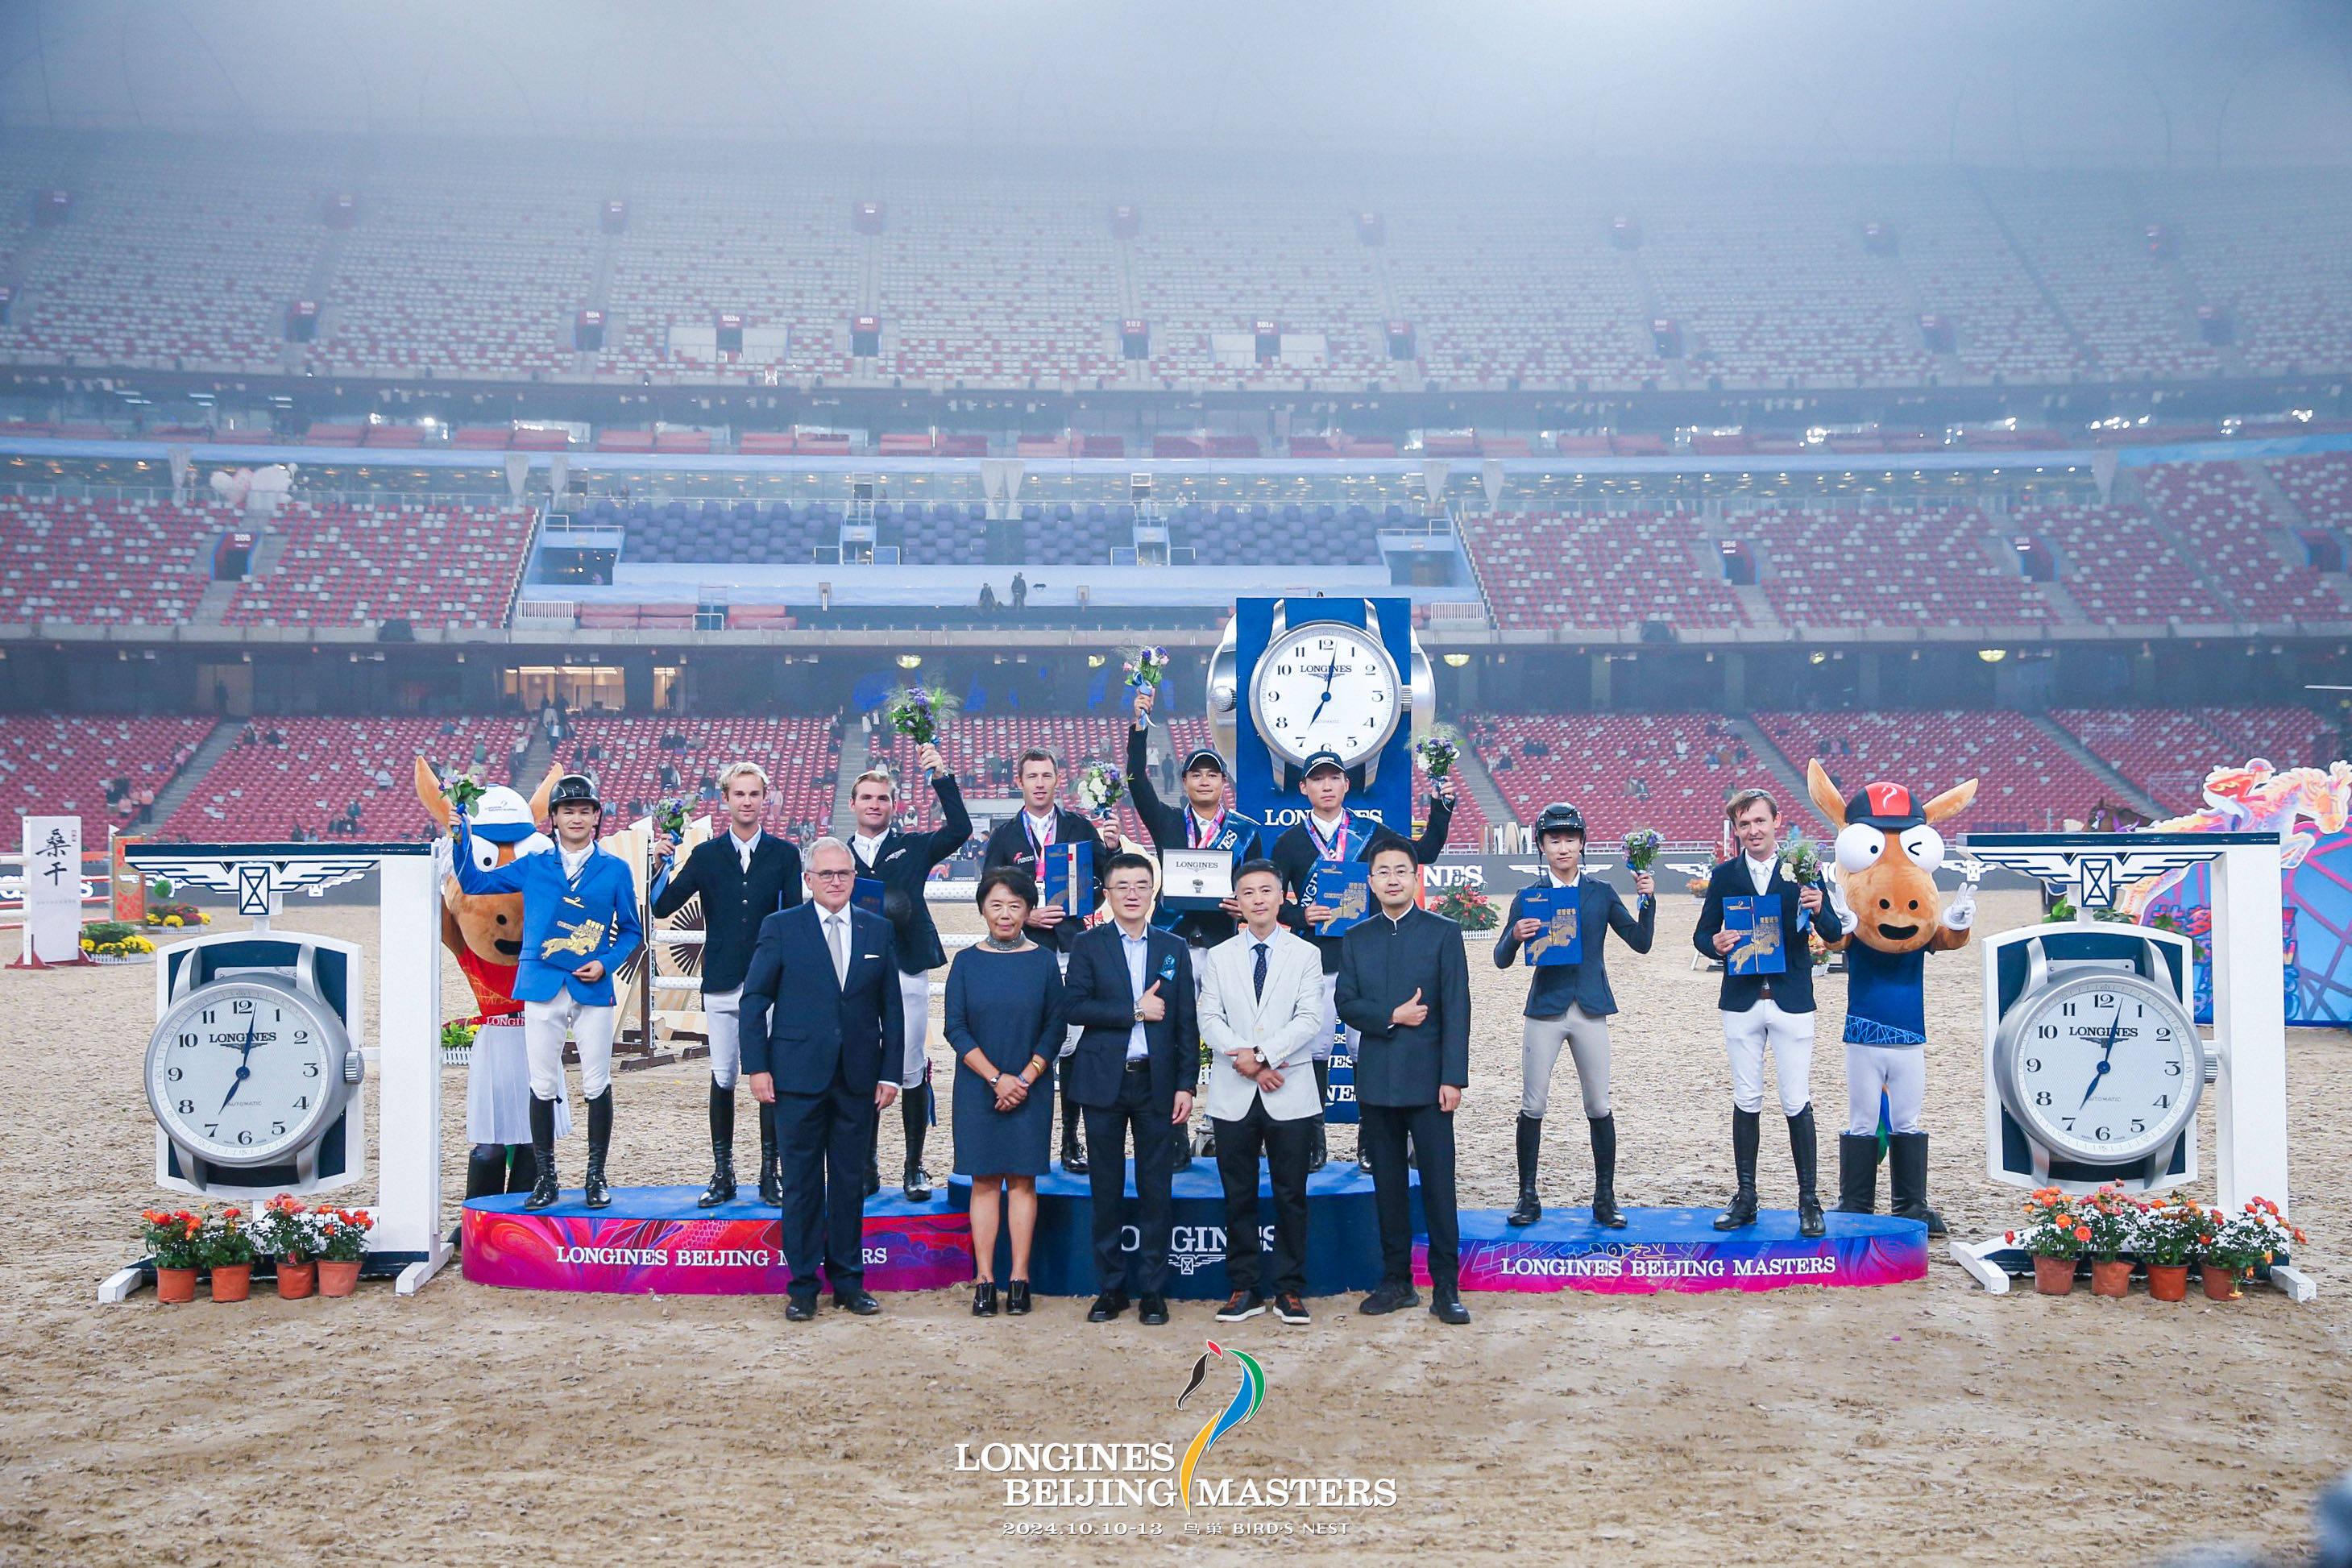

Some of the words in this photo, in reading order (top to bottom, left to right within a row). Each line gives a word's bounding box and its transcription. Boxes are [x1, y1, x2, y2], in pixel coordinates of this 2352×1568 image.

[1295, 646, 1305, 657] 11
[1319, 639, 1334, 650] 12
[1351, 646, 1355, 657] 1
[1277, 665, 1292, 676] 10
[1365, 665, 1376, 676] 2
[1268, 691, 1280, 702] 9
[1371, 691, 1384, 703] 3
[1276, 717, 1288, 728] 8
[1363, 716, 1376, 728] 4
[1295, 736, 1306, 748] 7
[1346, 736, 1358, 748] 5
[1176, 861, 1218, 869] LONGINES
[232, 1000, 253, 1014] 12
[2094, 993, 2114, 1008] 12
[274, 1008, 280, 1023] 1
[2063, 1002, 2076, 1017] 11
[2137, 1004, 2143, 1018] 1
[201, 1010, 215, 1024] 11
[209, 1032, 276, 1043] LONGINES
[293, 1031, 309, 1044] 2
[2038, 1025, 2058, 1039] 10
[2069, 1027, 2138, 1037] LONGINES
[2155, 1027, 2172, 1042] 2
[178, 1033, 198, 1047] 10
[302, 1062, 319, 1077] 3
[2026, 1058, 2042, 1072] 9
[2164, 1060, 2181, 1076] 3
[168, 1067, 183, 1082] 9
[292, 1096, 309, 1110] 4
[2035, 1091, 2052, 1106] 8
[2152, 1094, 2170, 1109] 4
[178, 1099, 195, 1114] 8
[204, 1123, 219, 1138] 7
[272, 1121, 286, 1135] 5
[2061, 1117, 2076, 1131] 7
[2130, 1118, 2145, 1133] 5
[237, 1130, 253, 1145] 6
[2095, 1126, 2110, 1141] 6
[1121, 1225, 1276, 1252] OGINS
[556, 1247, 668, 1266] LONGINES
[675, 1249, 769, 1267] BEIJING
[1500, 1257, 1623, 1277] LONGINES
[1631, 1259, 1725, 1277] BEIJING
[1732, 1256, 1836, 1276] MASTERS
